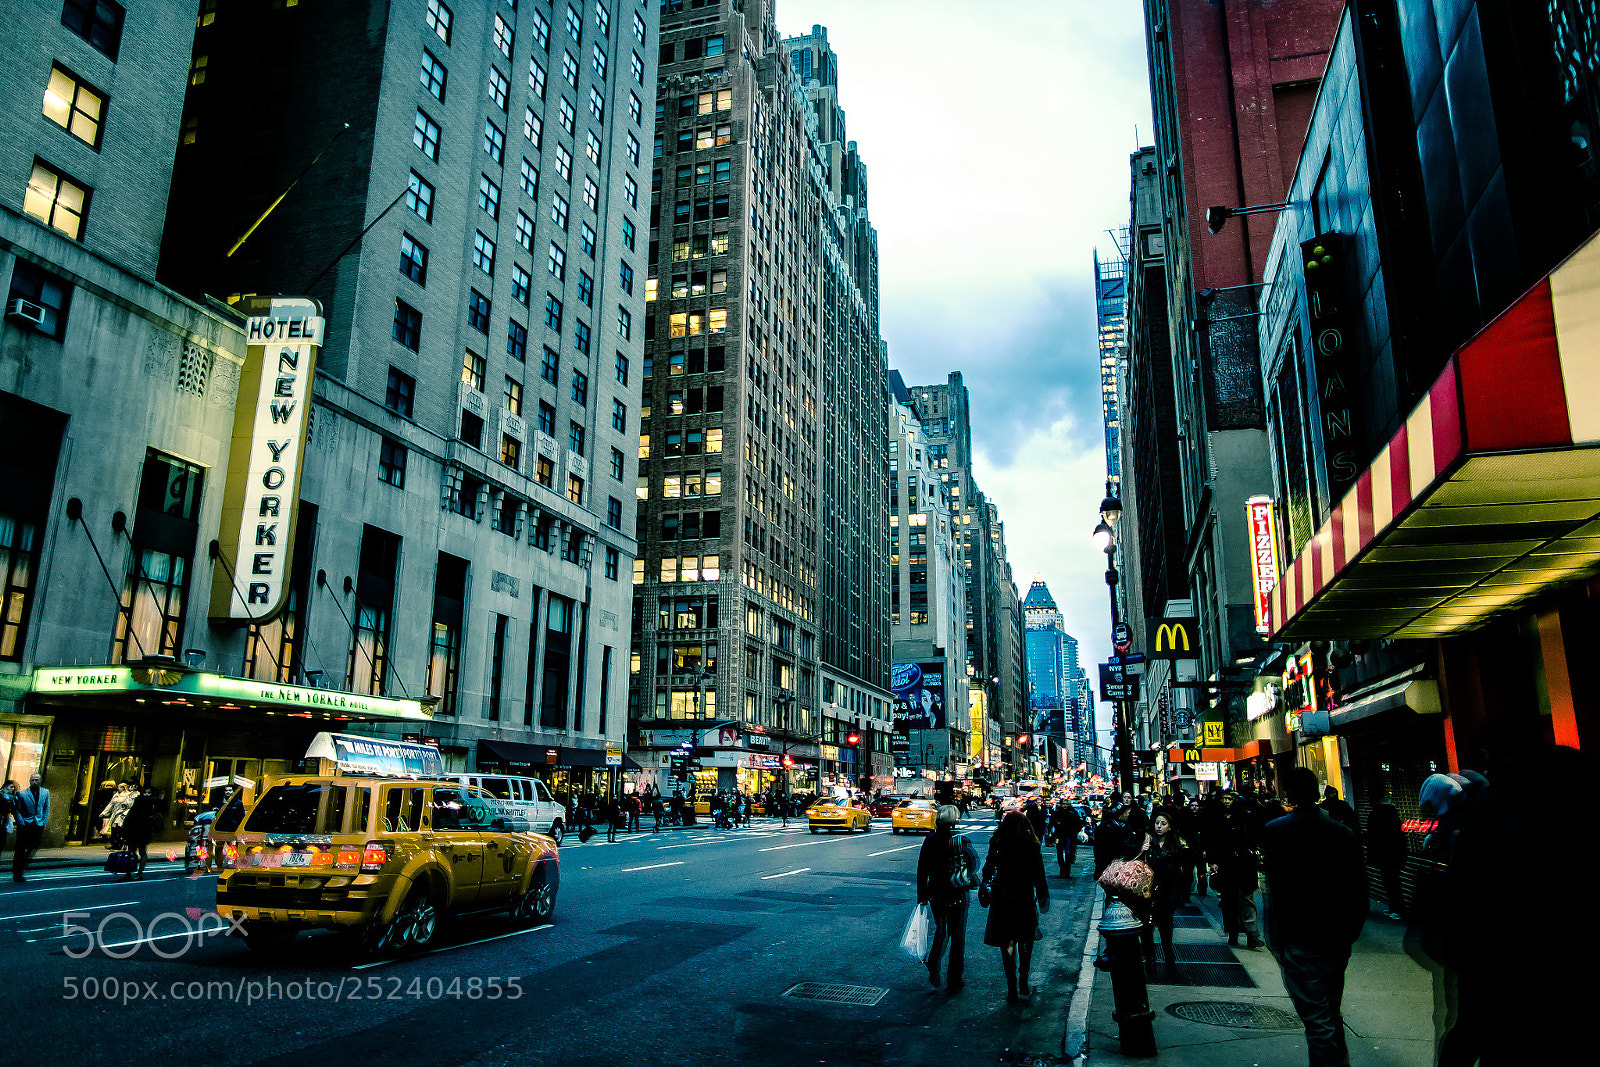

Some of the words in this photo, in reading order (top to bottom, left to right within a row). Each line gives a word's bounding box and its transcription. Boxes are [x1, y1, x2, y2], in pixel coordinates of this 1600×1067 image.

[249, 318, 315, 339] HOTEL
[269, 346, 299, 424] NEW
[1311, 290, 1357, 482] LOANS
[248, 438, 291, 604] YORKER
[1253, 506, 1275, 623] PIZZER
[51, 676, 72, 685] NEW
[77, 674, 117, 685] YORKER
[260, 690, 274, 699] THE
[278, 688, 300, 702] NEW
[306, 692, 346, 707] YORKER
[349, 701, 369, 710] HOTEL
